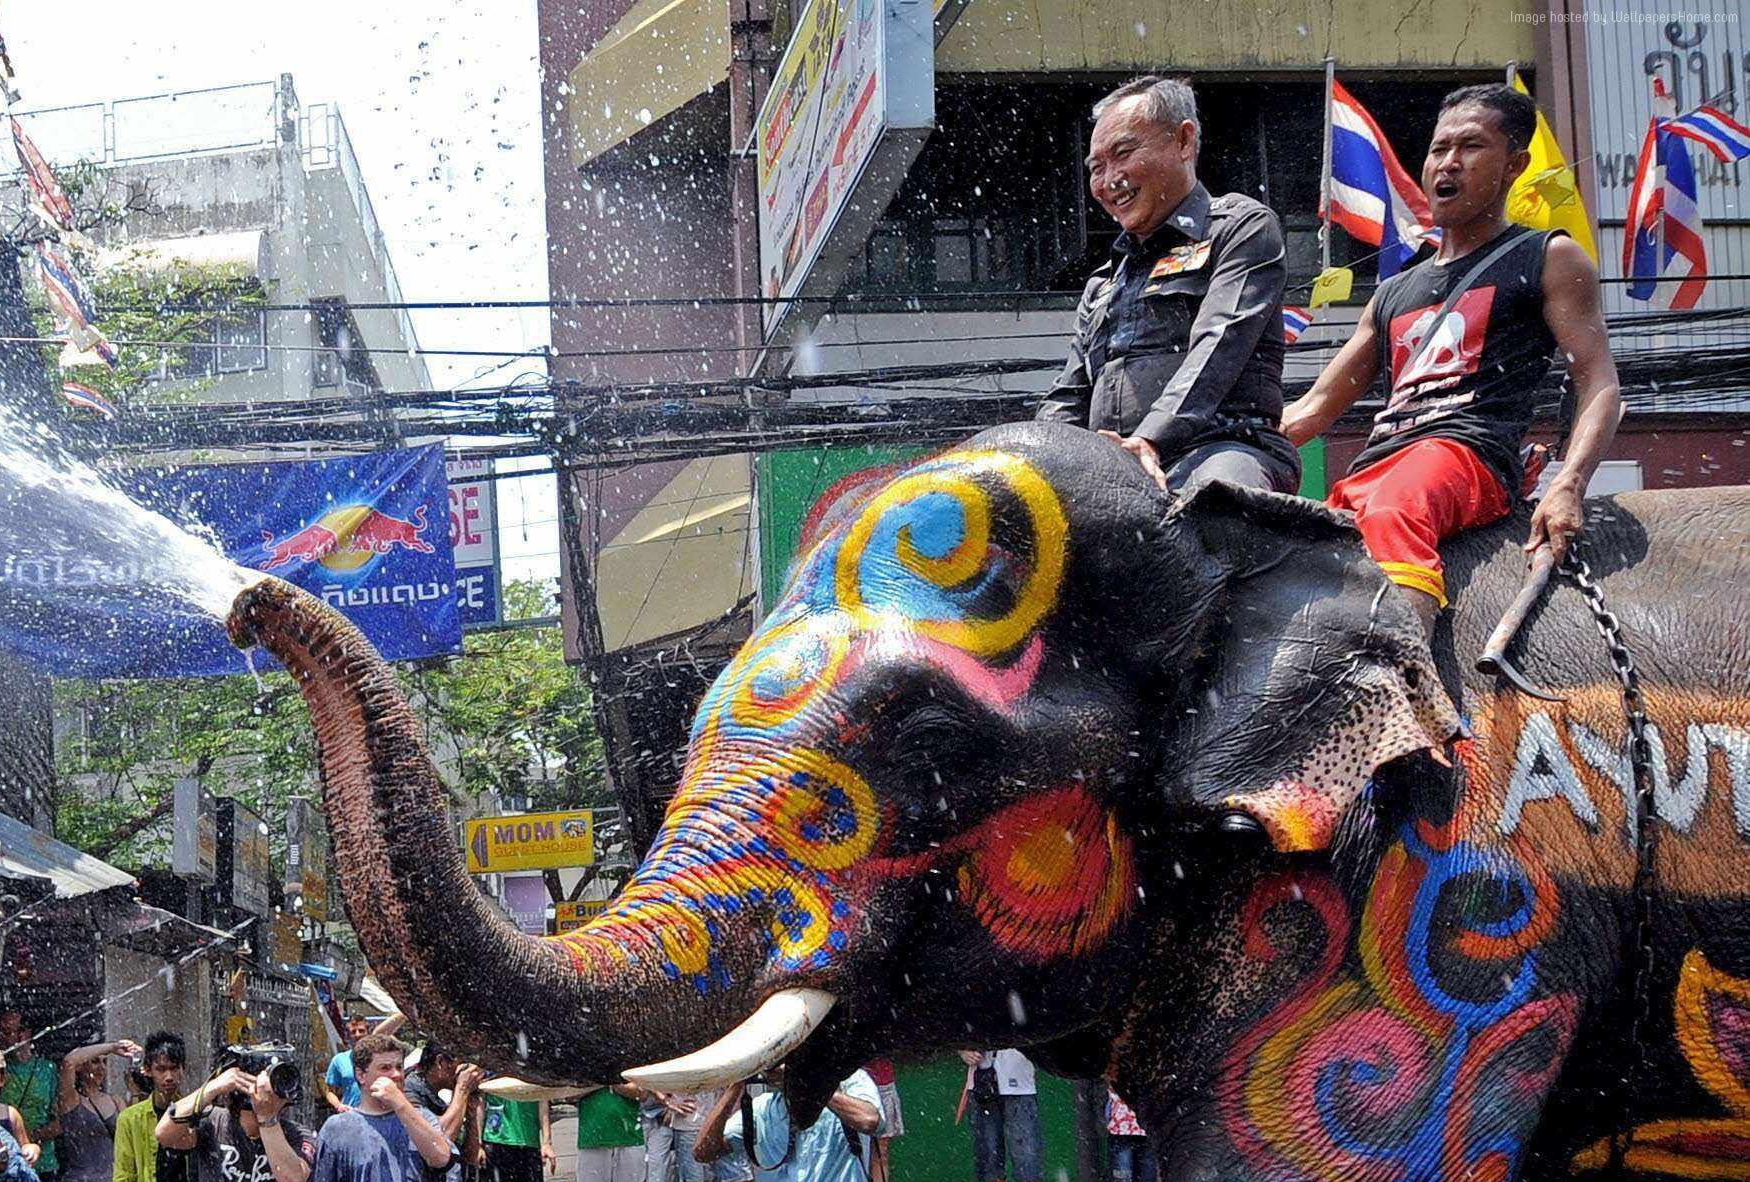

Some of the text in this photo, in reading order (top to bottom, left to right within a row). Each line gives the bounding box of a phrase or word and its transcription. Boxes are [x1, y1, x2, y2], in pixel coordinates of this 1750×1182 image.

[320, 582, 440, 607] ทิงแดง
[493, 820, 556, 845] MOM
